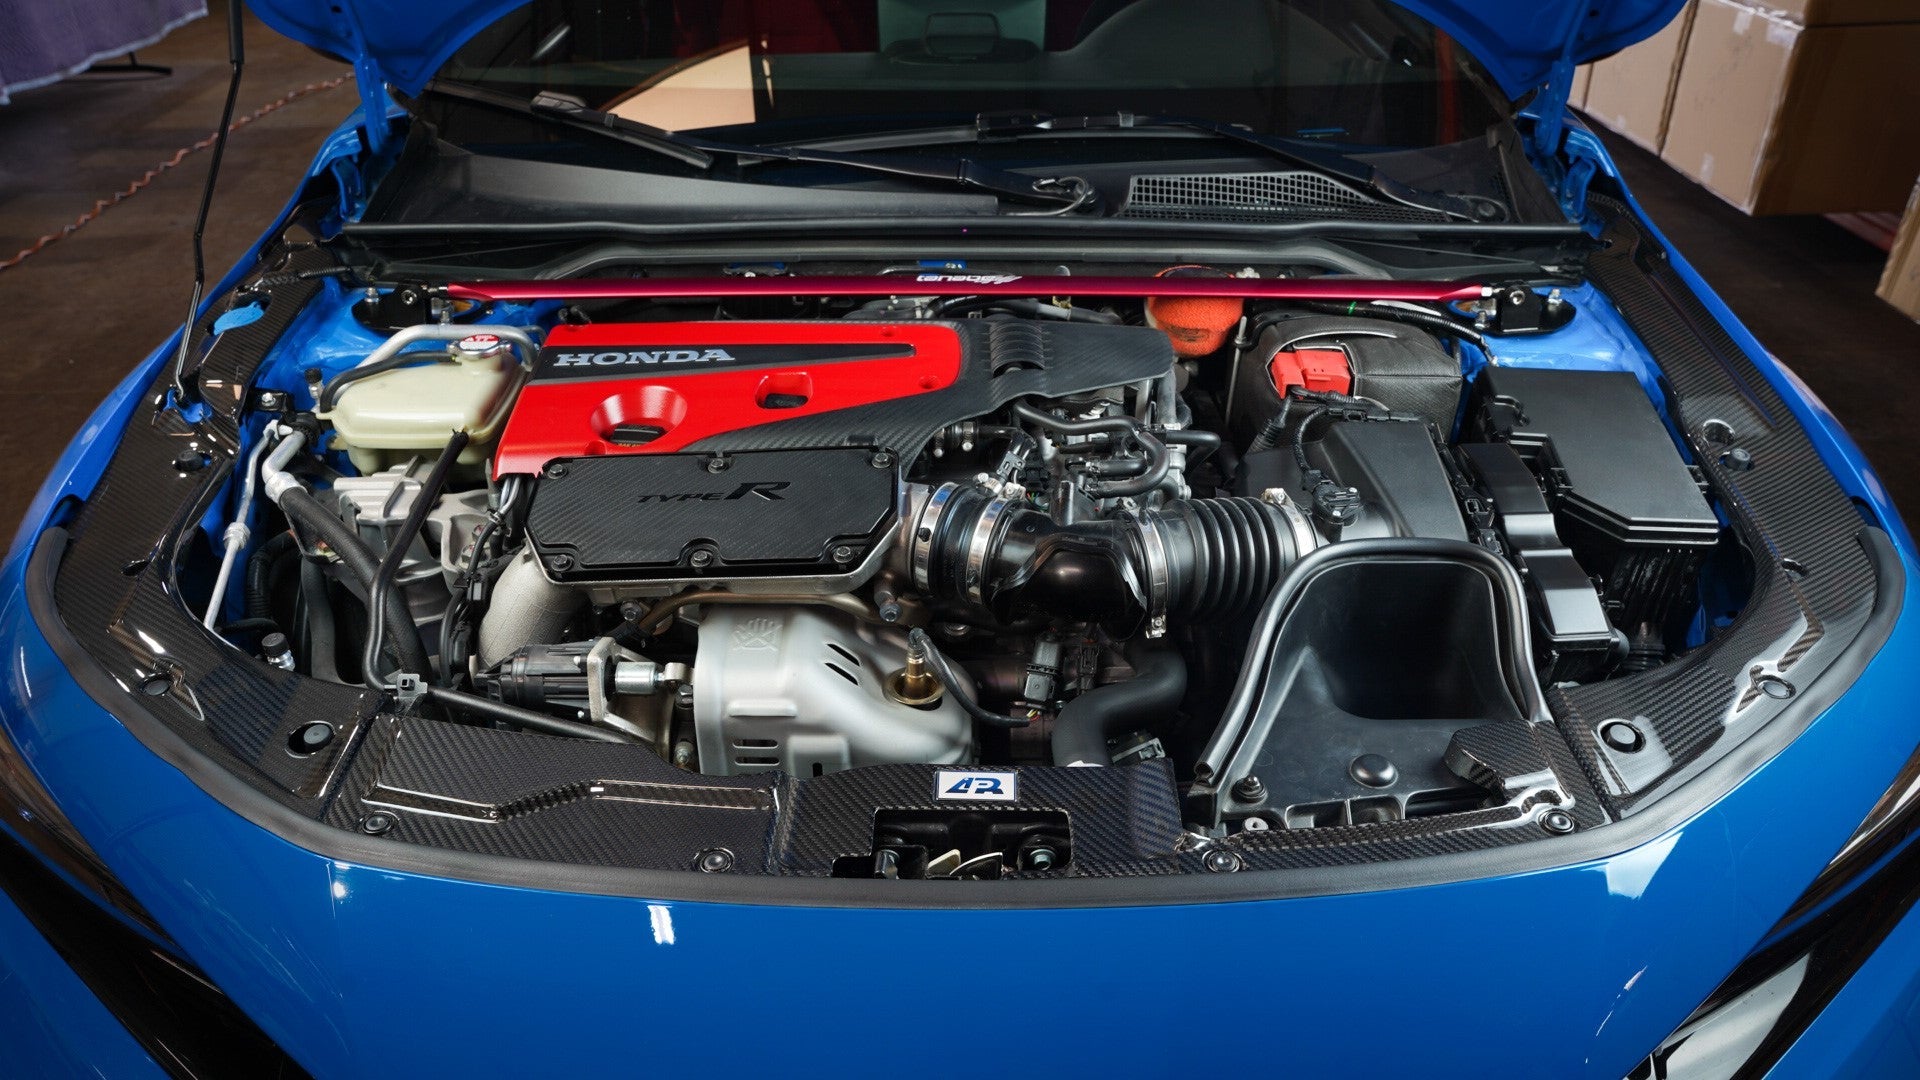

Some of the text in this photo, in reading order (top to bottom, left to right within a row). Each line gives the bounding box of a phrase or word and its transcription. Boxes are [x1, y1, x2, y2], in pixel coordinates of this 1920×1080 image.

[553, 348, 736, 367] HONDA
[637, 481, 791, 502] TYPE R
